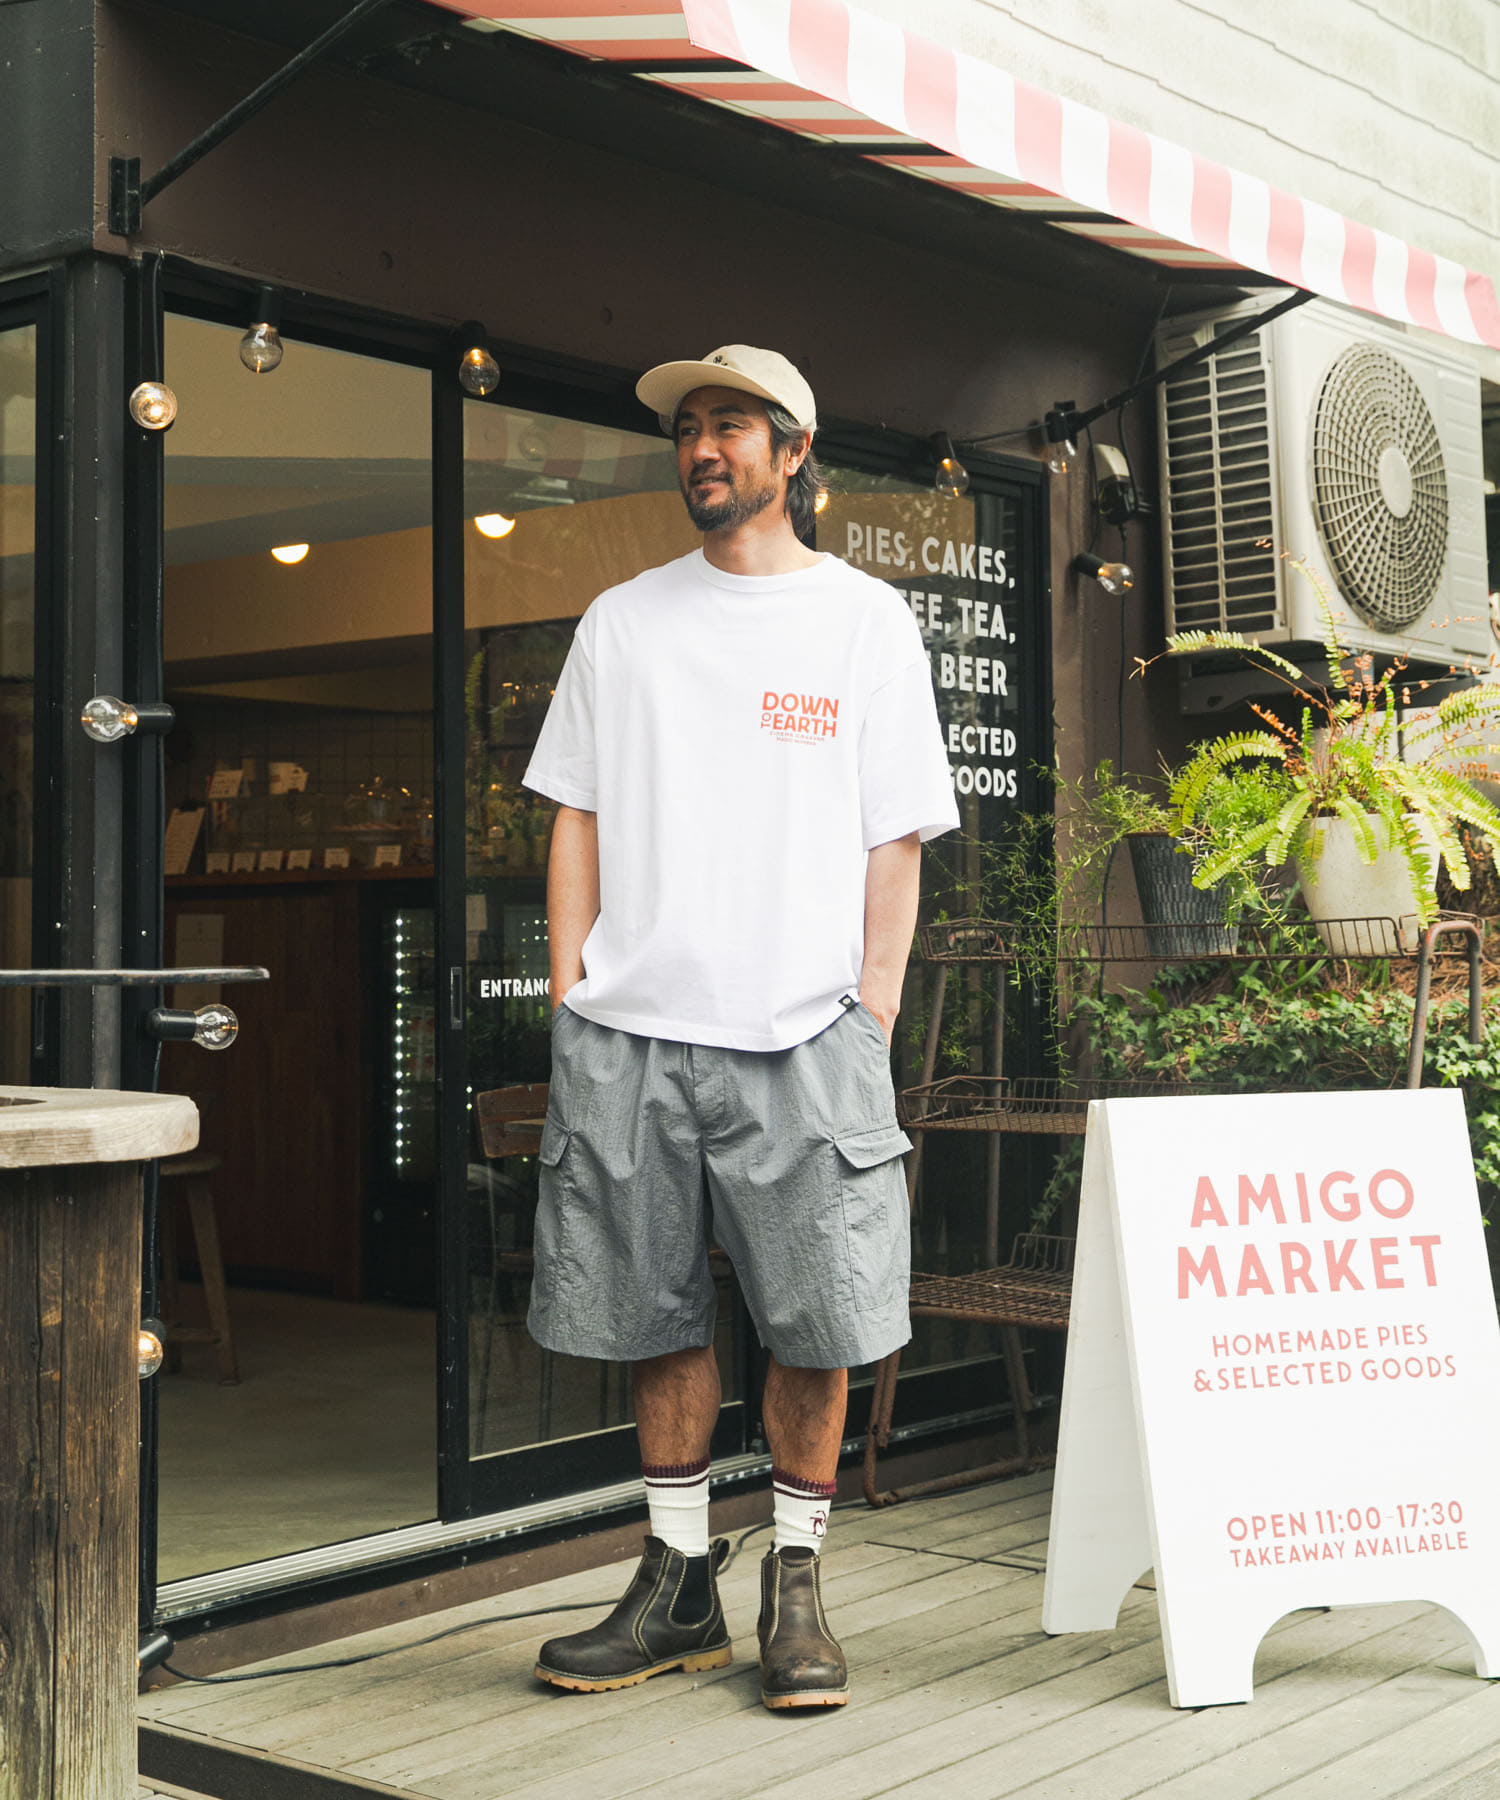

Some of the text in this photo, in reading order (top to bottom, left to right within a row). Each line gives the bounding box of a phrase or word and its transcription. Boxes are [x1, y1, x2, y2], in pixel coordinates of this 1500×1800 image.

[847, 521, 1015, 589] PIES, CAKES,
[957, 598, 1016, 644] TEA,
[941, 652, 1009, 696] BEER
[762, 691, 839, 719] DOWN
[773, 713, 837, 737] EARTH
[944, 724, 1017, 757] ECTED
[480, 978, 550, 998] ENTRANC
[1190, 1168, 1414, 1228] AMIGO
[1178, 1235, 1441, 1299] MARKET
[1212, 1324, 1428, 1358] HOMEMADE PIES
[1361, 1355, 1456, 1381] GOODS
[1227, 1512, 1307, 1541] OPEN
[1230, 1531, 1469, 1568] TAKEAWAY AVAILABLE
